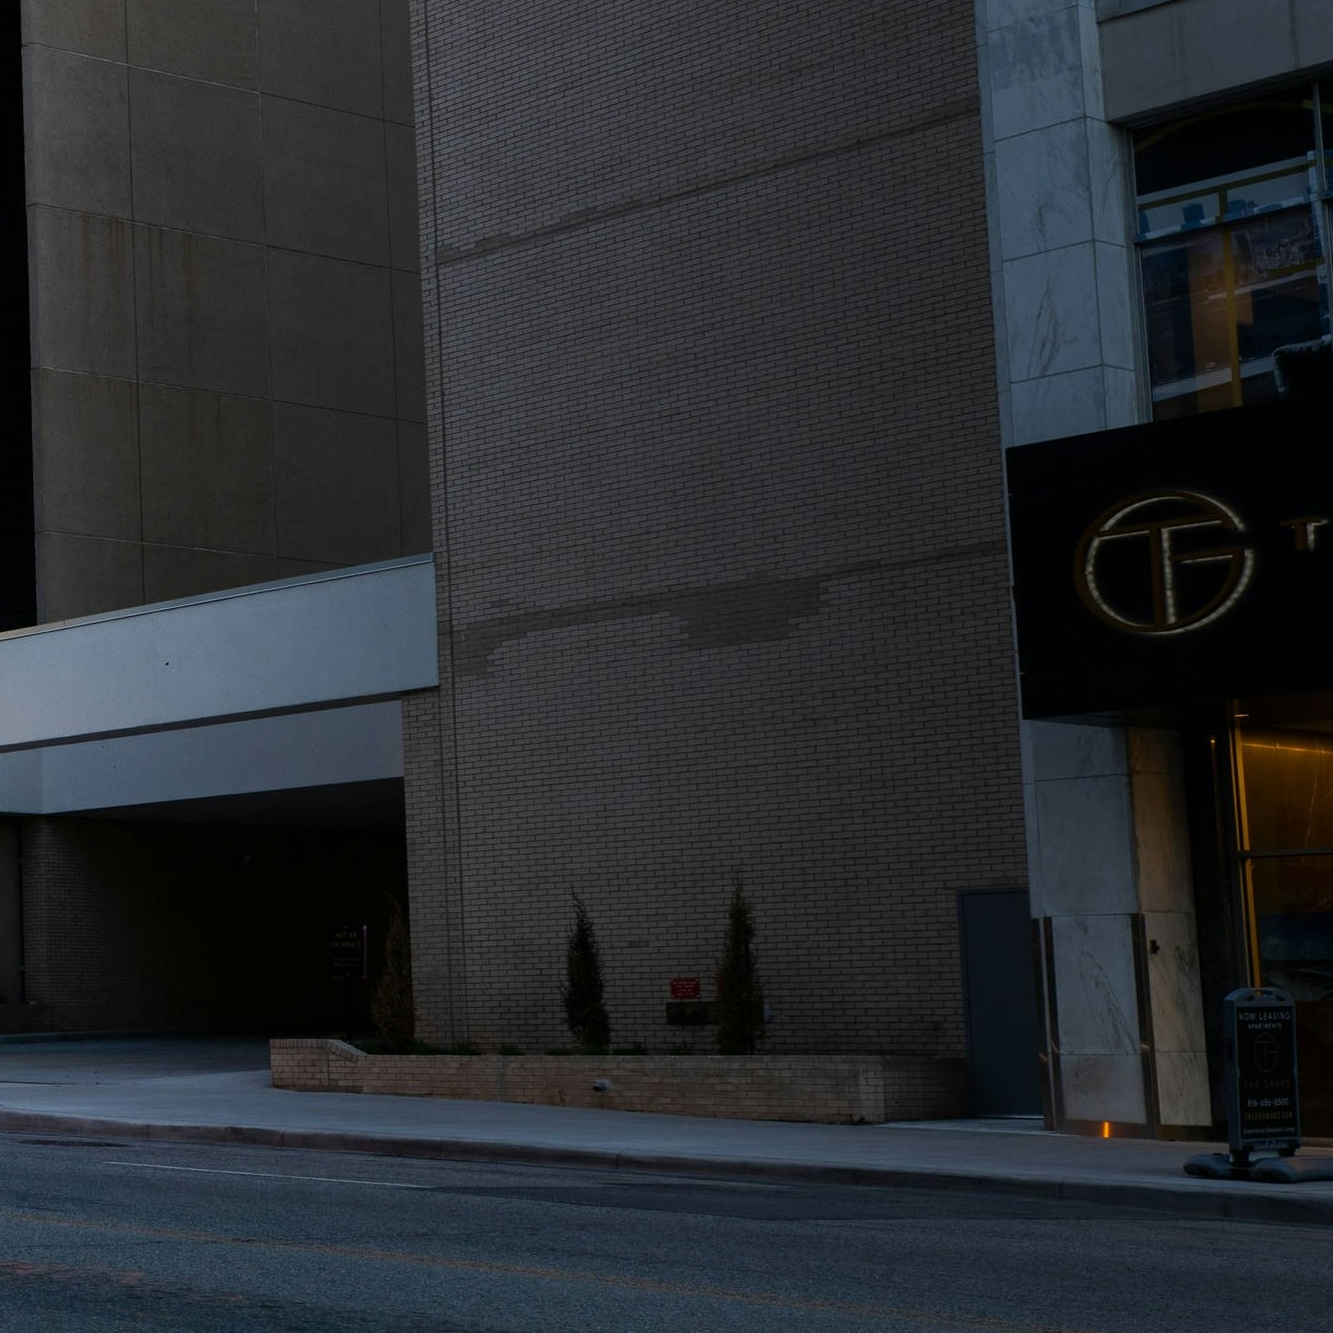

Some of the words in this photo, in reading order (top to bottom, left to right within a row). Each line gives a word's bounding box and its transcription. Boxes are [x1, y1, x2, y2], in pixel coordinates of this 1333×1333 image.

[1238, 1011, 1256, 1021] NOW
[1259, 1011, 1291, 1020] LEASING
[1247, 1022, 1283, 1030] APARTMENTS
